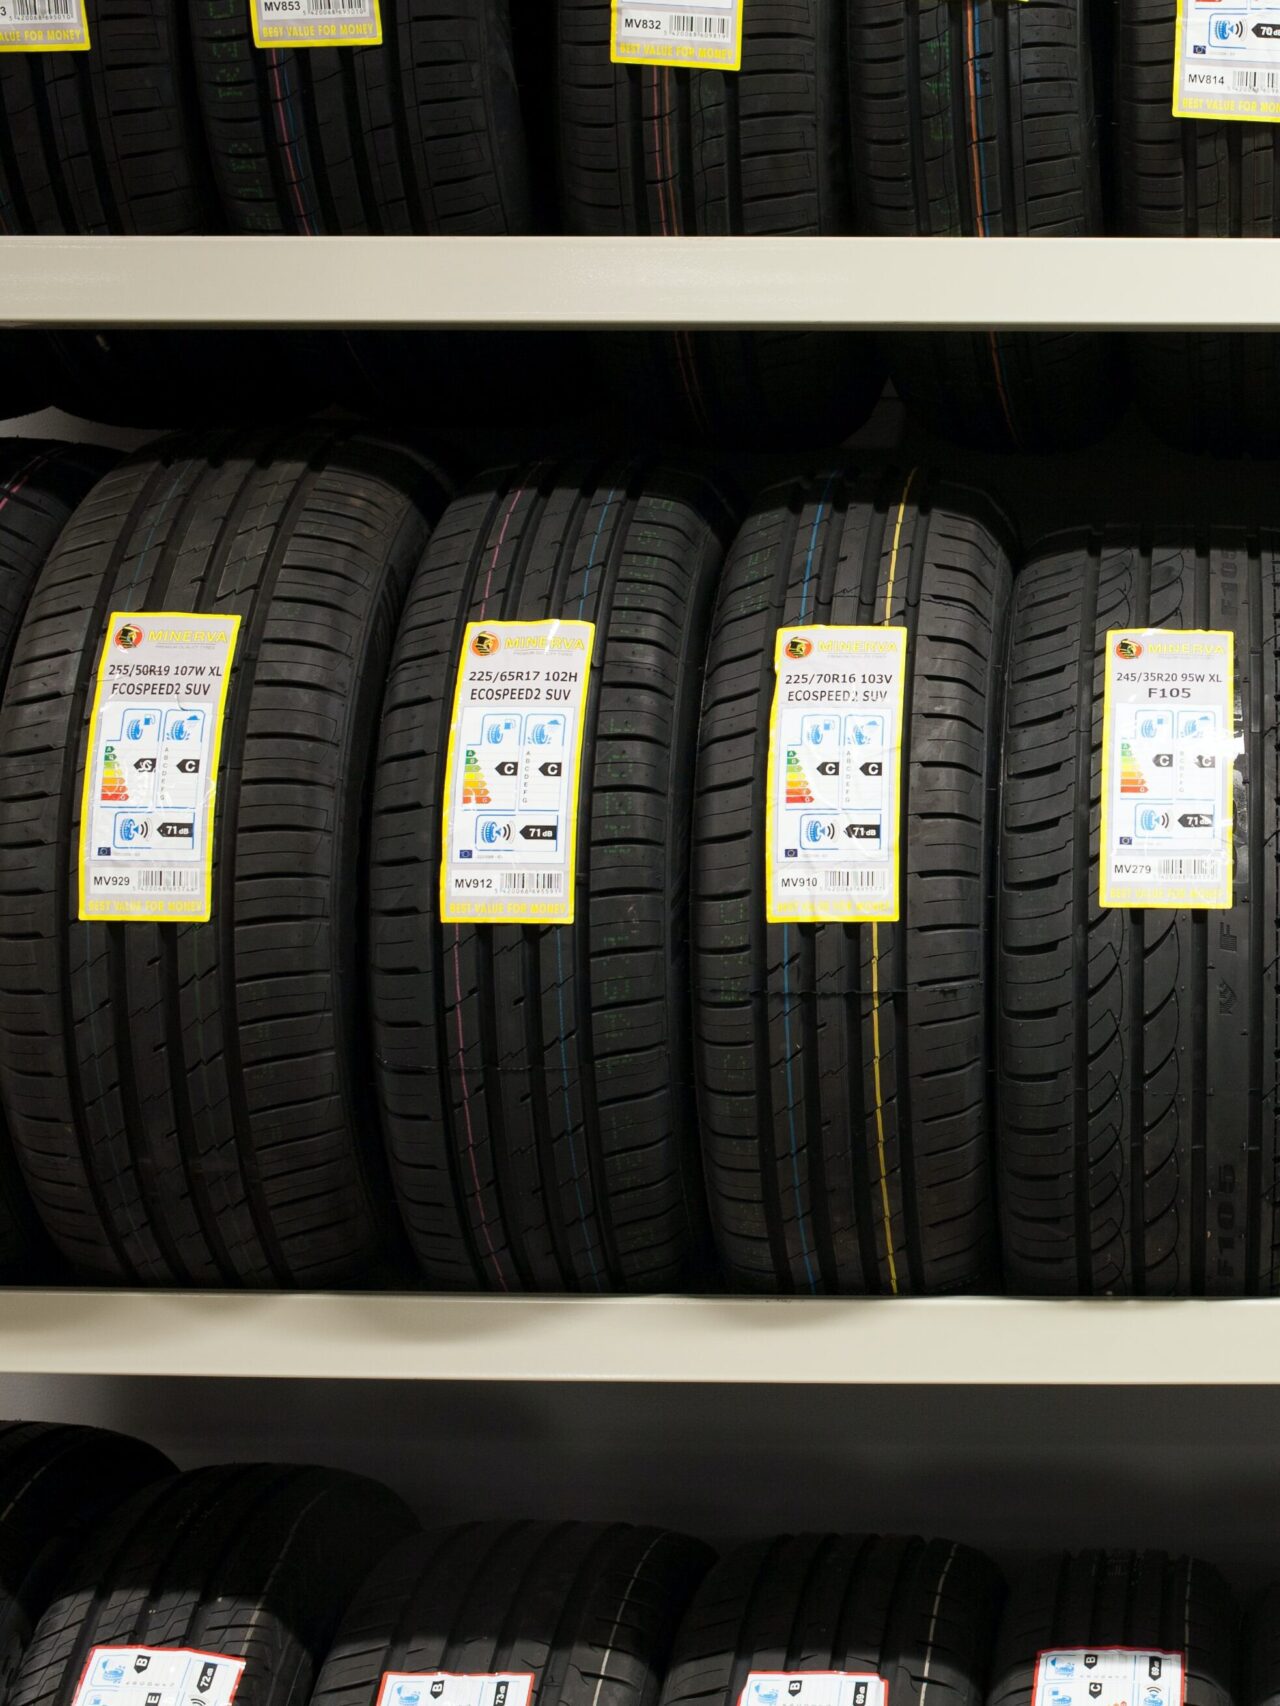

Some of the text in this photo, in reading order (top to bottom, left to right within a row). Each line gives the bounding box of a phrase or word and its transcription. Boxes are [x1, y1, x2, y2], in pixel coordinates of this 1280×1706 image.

[264, 1, 301, 11] MV853
[625, 18, 661, 29] MV832
[0, 29, 81, 41] ALUE FOR MONEY
[263, 23, 373, 37] BEST VALUE FOR MONEY
[1260, 26, 1272, 35] 70
[1188, 74, 1225, 85] MV814
[148, 629, 228, 643] MINERVA
[504, 635, 585, 650] MINERVA
[108, 664, 223, 678] 255/50R19 107W XL
[469, 671, 579, 683] 225/65R17 102H
[785, 673, 893, 685] 225/70R16 103V
[1116, 672, 1223, 683] 245/35R20 95W XL
[185, 684, 211, 697] SUV
[470, 688, 572, 701] ECOSPEED2 SUV
[1148, 688, 1192, 699] F105
[862, 690, 888, 702] SUV
[1159, 756, 1169, 767] C
[185, 762, 196, 772] C
[504, 764, 514, 774] C
[547, 764, 558, 774] C
[825, 764, 836, 774] C
[868, 764, 879, 774] C
[1187, 817, 1198, 826] 71
[166, 825, 189, 835] 71 dB
[529, 828, 553, 837] 71 dB
[853, 827, 864, 836] 71
[1114, 865, 1152, 874] MV279
[94, 876, 130, 886] MV929
[455, 879, 492, 889] MV912
[781, 878, 817, 888] MV910
[136, 1657, 148, 1667] B
[1085, 1656, 1096, 1664] B
[200, 1674, 211, 1687] 72
[431, 1683, 443, 1692] B
[789, 1682, 801, 1691] B
[1090, 1683, 1101, 1692] C
[148, 1693, 159, 1704] E
